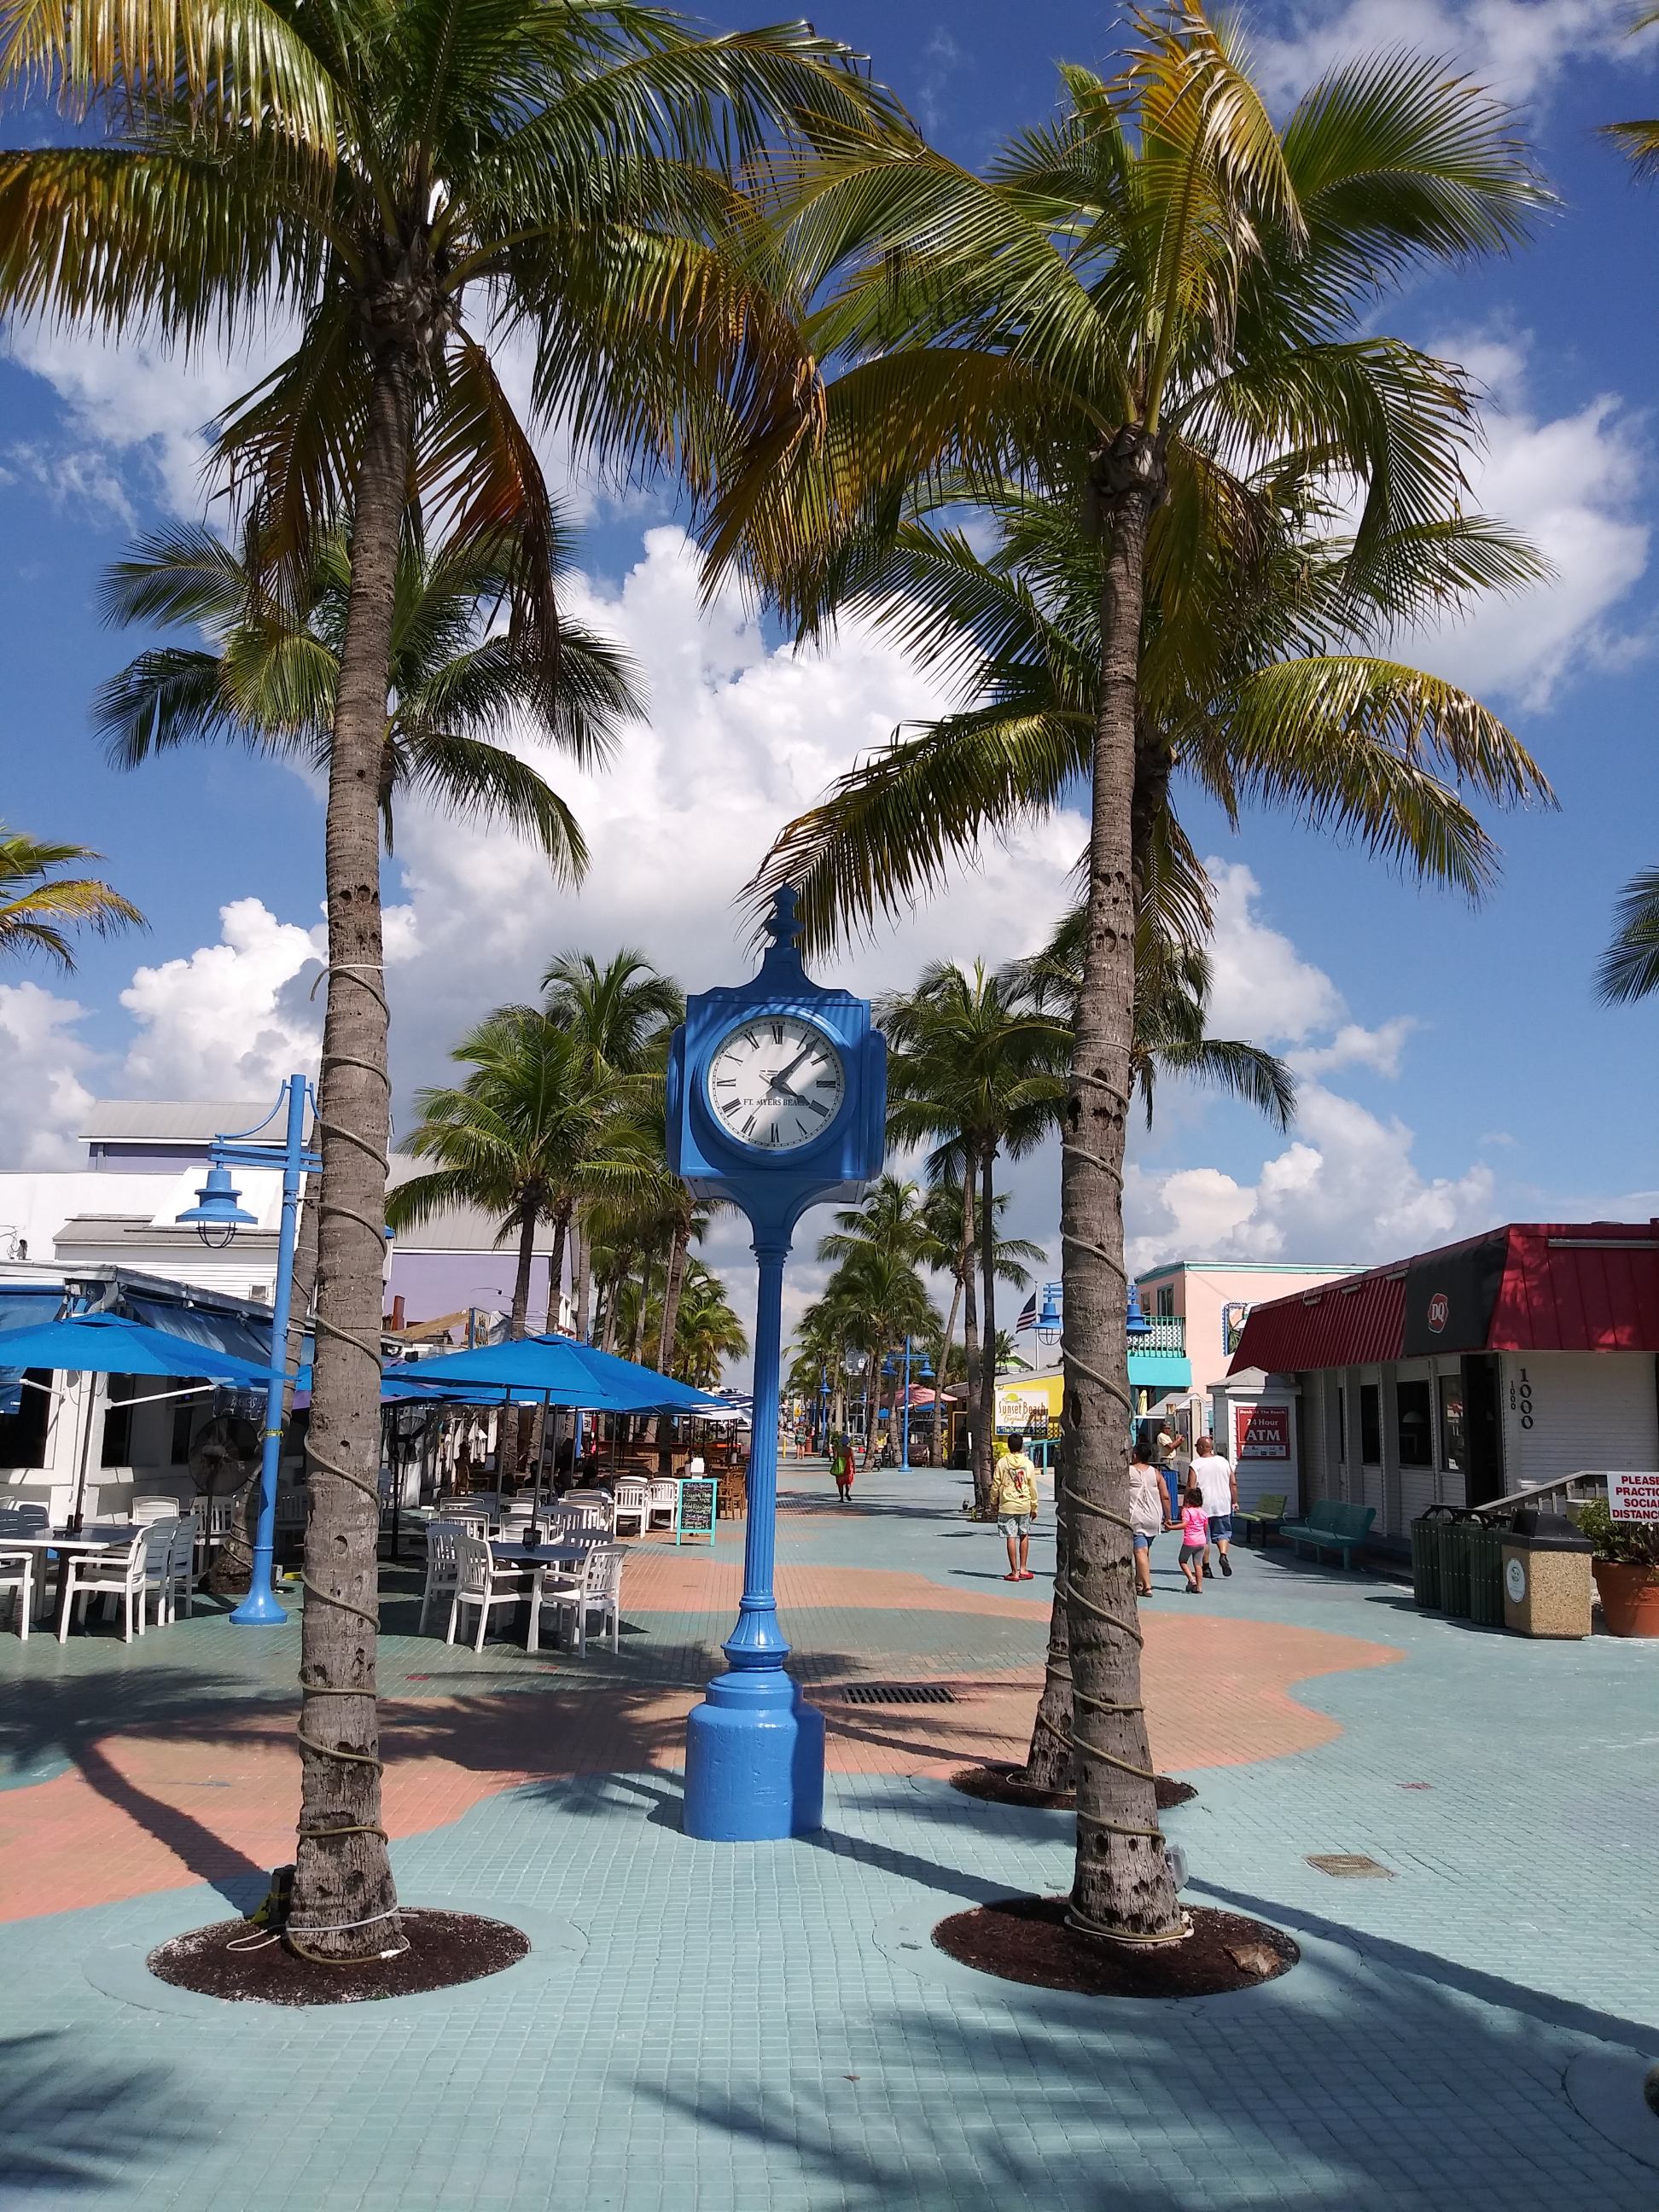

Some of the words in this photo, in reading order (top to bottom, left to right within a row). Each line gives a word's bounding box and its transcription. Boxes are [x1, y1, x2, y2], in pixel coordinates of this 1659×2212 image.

[783, 1098, 809, 1107] BEAC
[1431, 1301, 1445, 1323] DQ
[1519, 1368, 1534, 1429] 1000
[998, 1400, 1022, 1415] Sunset
[1022, 1400, 1045, 1416] Beach
[1246, 1429, 1281, 1441] ATM
[1623, 1498, 1659, 1508] SOCIA
[1612, 1509, 1659, 1519] DISTANC
